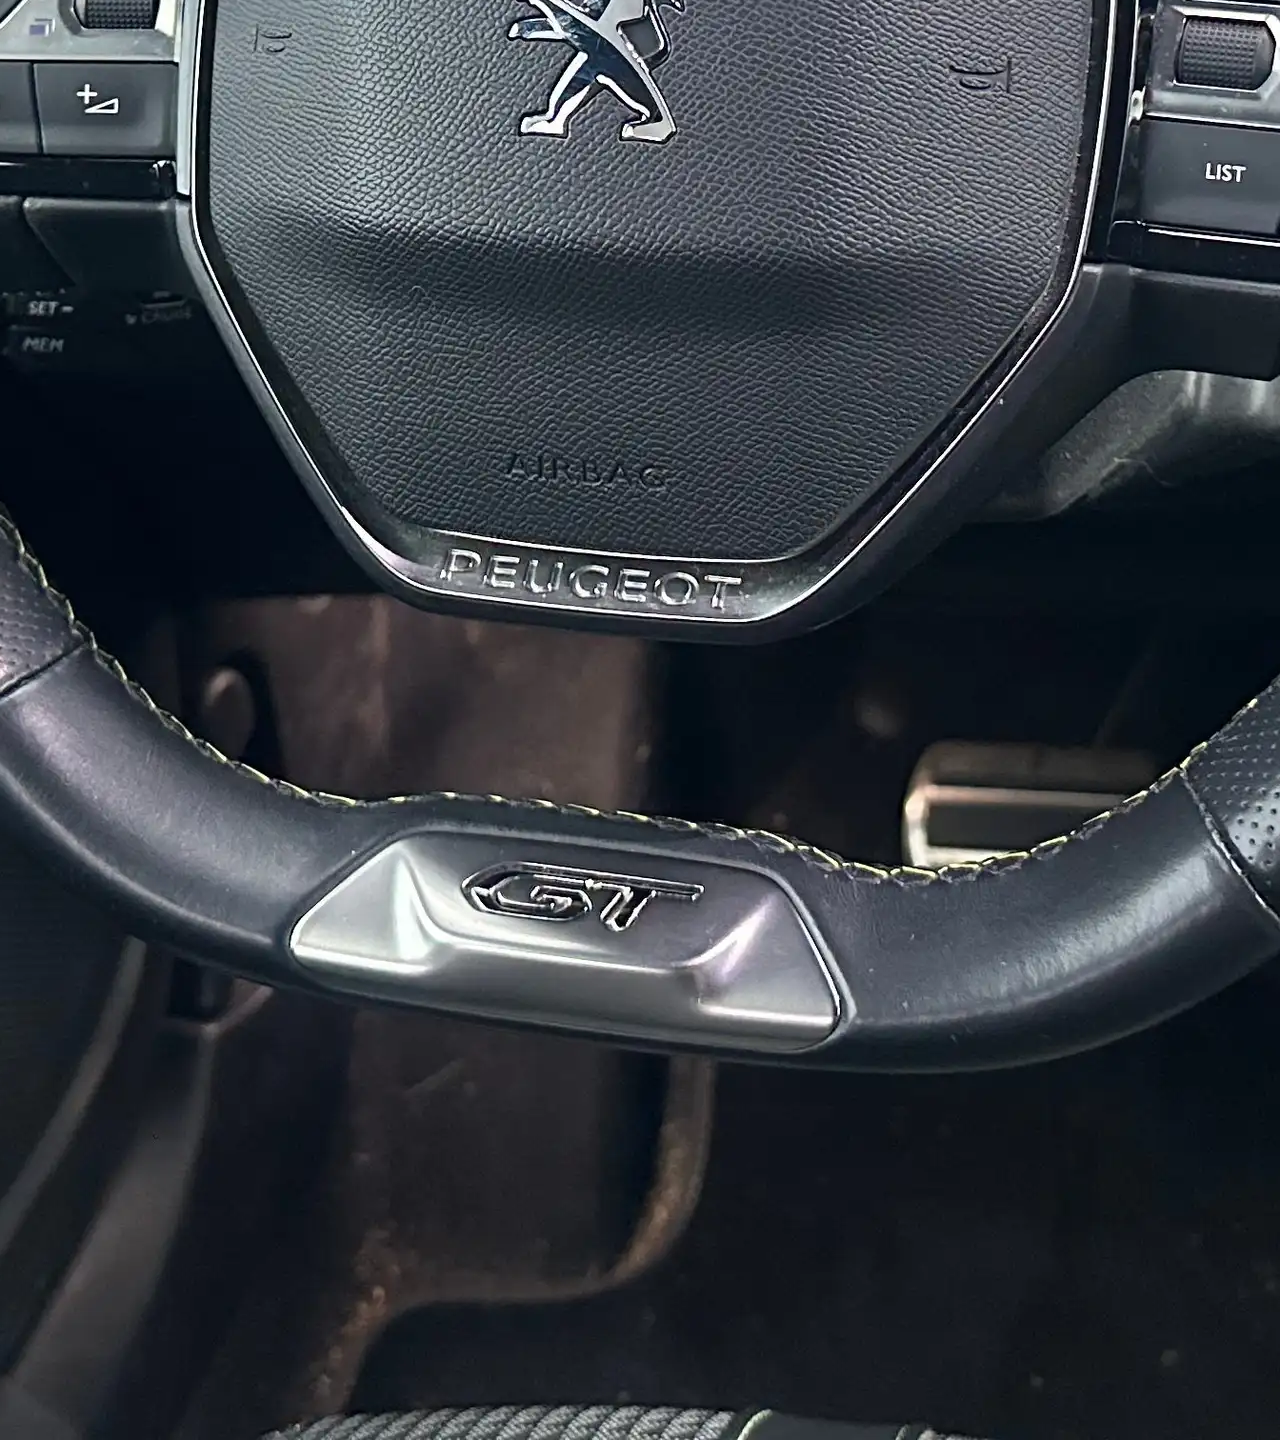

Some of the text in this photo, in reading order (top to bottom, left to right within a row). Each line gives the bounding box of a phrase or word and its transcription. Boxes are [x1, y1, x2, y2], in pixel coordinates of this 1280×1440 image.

[1204, 162, 1247, 184] LIST
[506, 455, 669, 490] AIRBAG
[438, 547, 743, 611] PEUGEOT
[460, 860, 705, 933] GT
